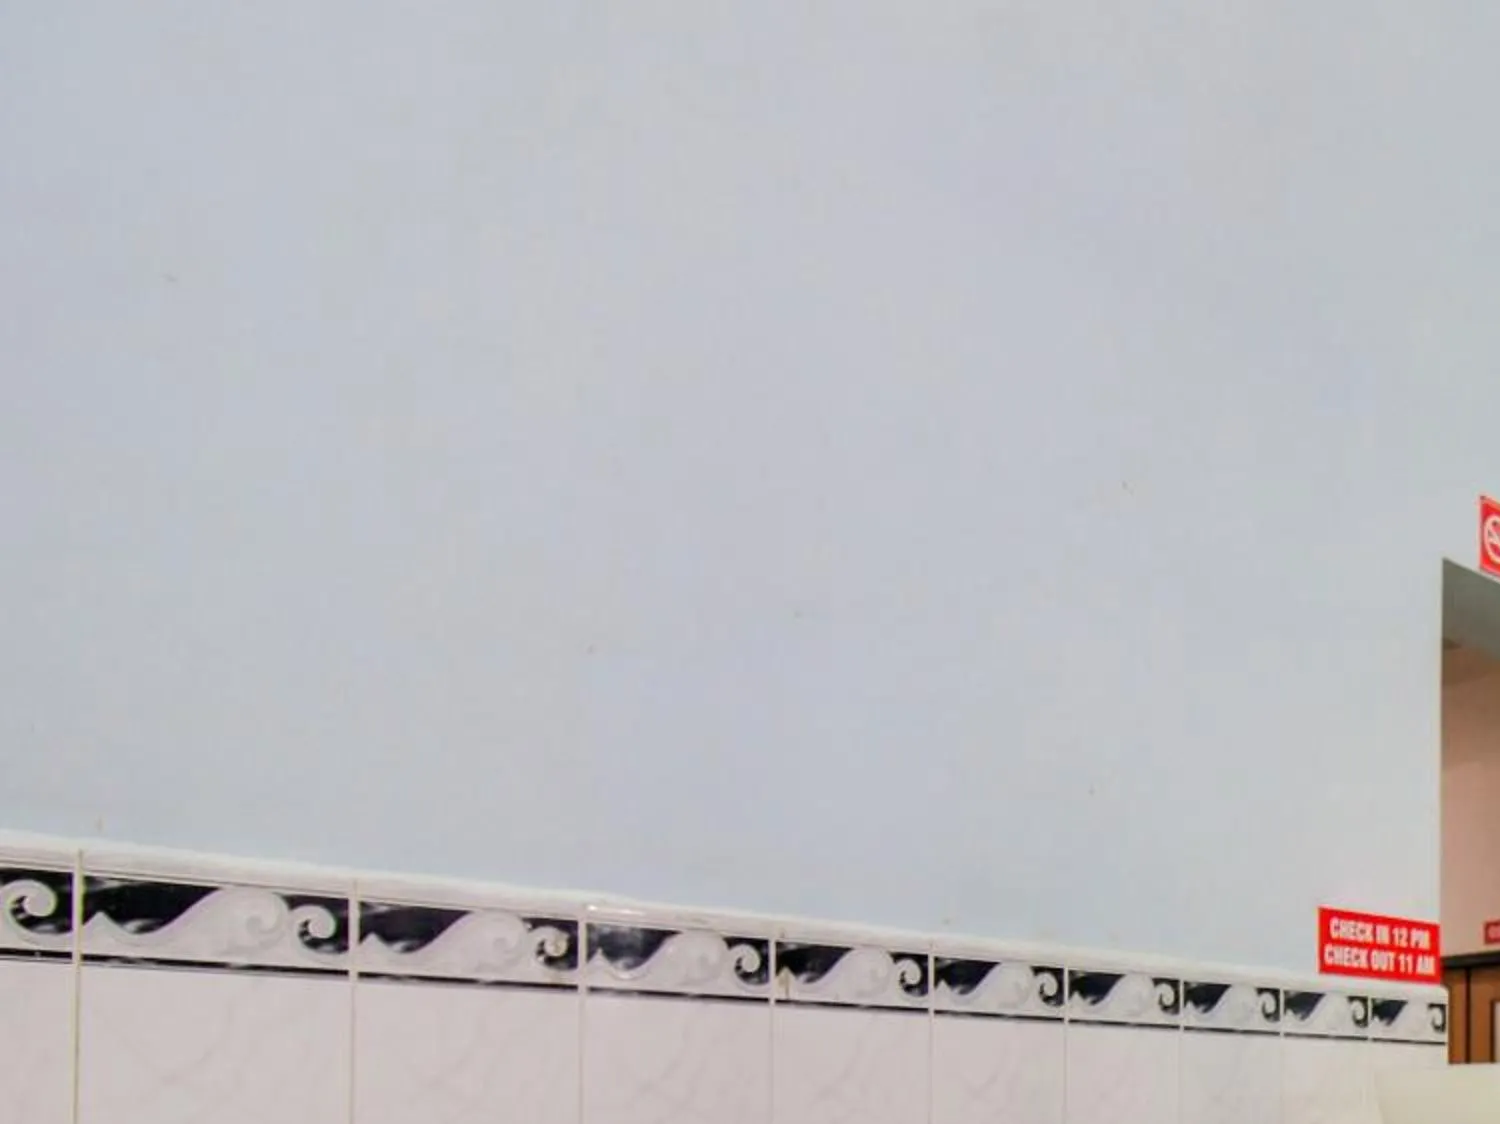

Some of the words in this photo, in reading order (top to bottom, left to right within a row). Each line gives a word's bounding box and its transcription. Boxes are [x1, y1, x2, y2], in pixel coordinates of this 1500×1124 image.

[1329, 917, 1374, 942] CHECK
[1375, 923, 1391, 945] IN
[1392, 926, 1409, 948] 12
[1410, 928, 1431, 950] PM
[1324, 943, 1369, 969] CHECK
[1370, 948, 1395, 972] OUT
[1398, 952, 1414, 974] 11
[1415, 955, 1436, 976] AM
